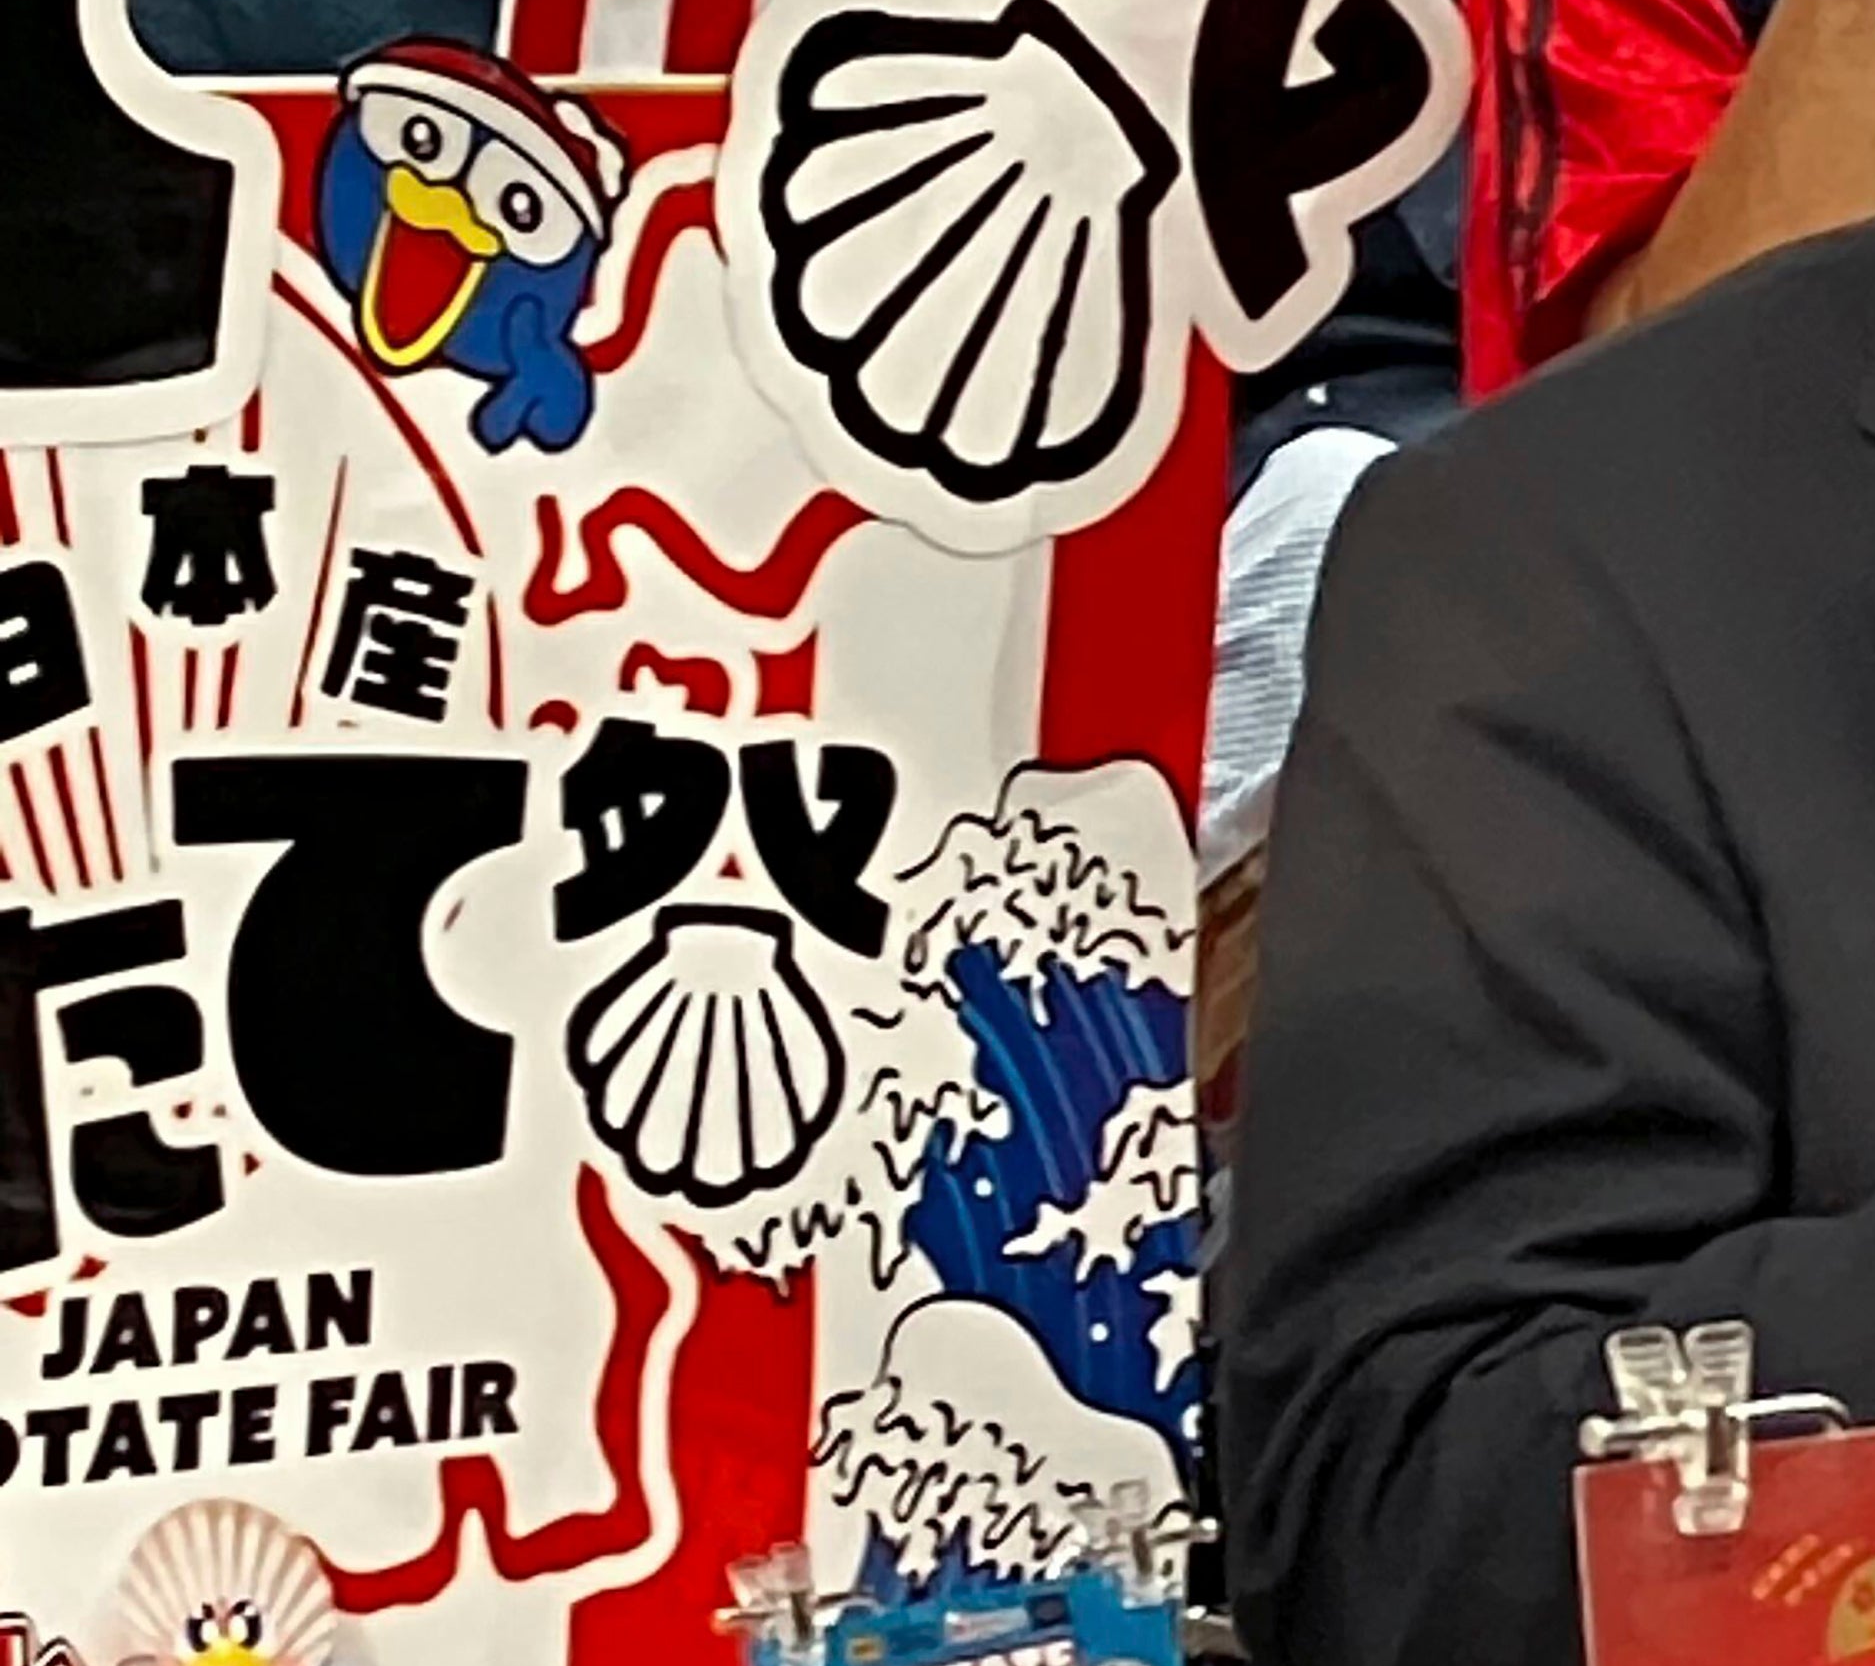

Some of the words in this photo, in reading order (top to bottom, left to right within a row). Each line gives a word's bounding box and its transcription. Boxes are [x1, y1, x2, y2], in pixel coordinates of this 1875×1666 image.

[40, 1268, 374, 1380] JAPAN
[0, 1384, 277, 1487] TATE
[305, 1361, 520, 1456] FAIR
